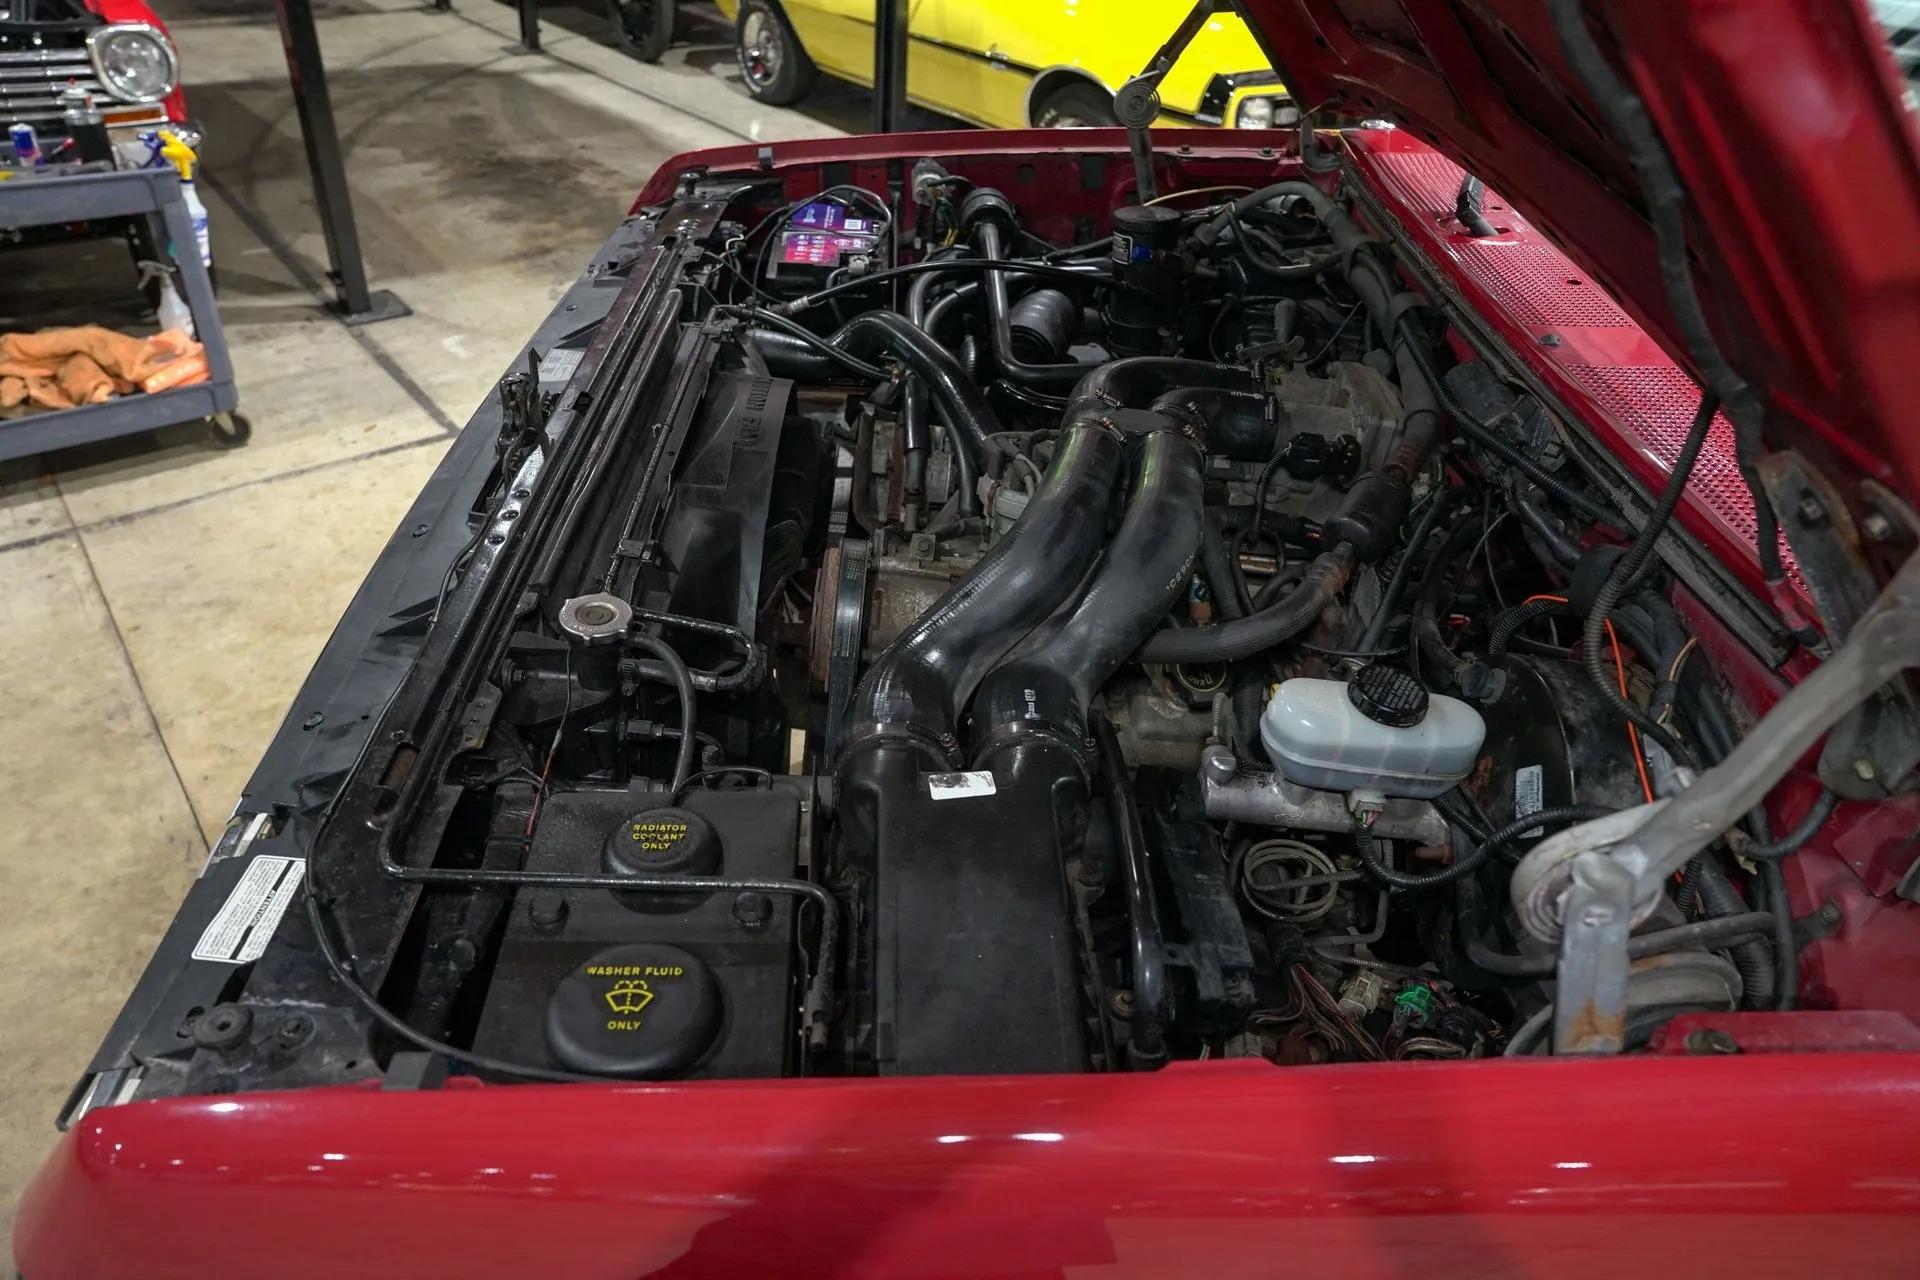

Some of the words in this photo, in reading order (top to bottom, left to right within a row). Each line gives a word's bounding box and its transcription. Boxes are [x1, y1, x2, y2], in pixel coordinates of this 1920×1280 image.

[633, 824, 687, 832] RADIATOR
[642, 842, 671, 850] ONLY
[587, 967, 641, 976] WASHER
[645, 967, 683, 976] FLUID
[607, 1021, 641, 1030] ONLY
